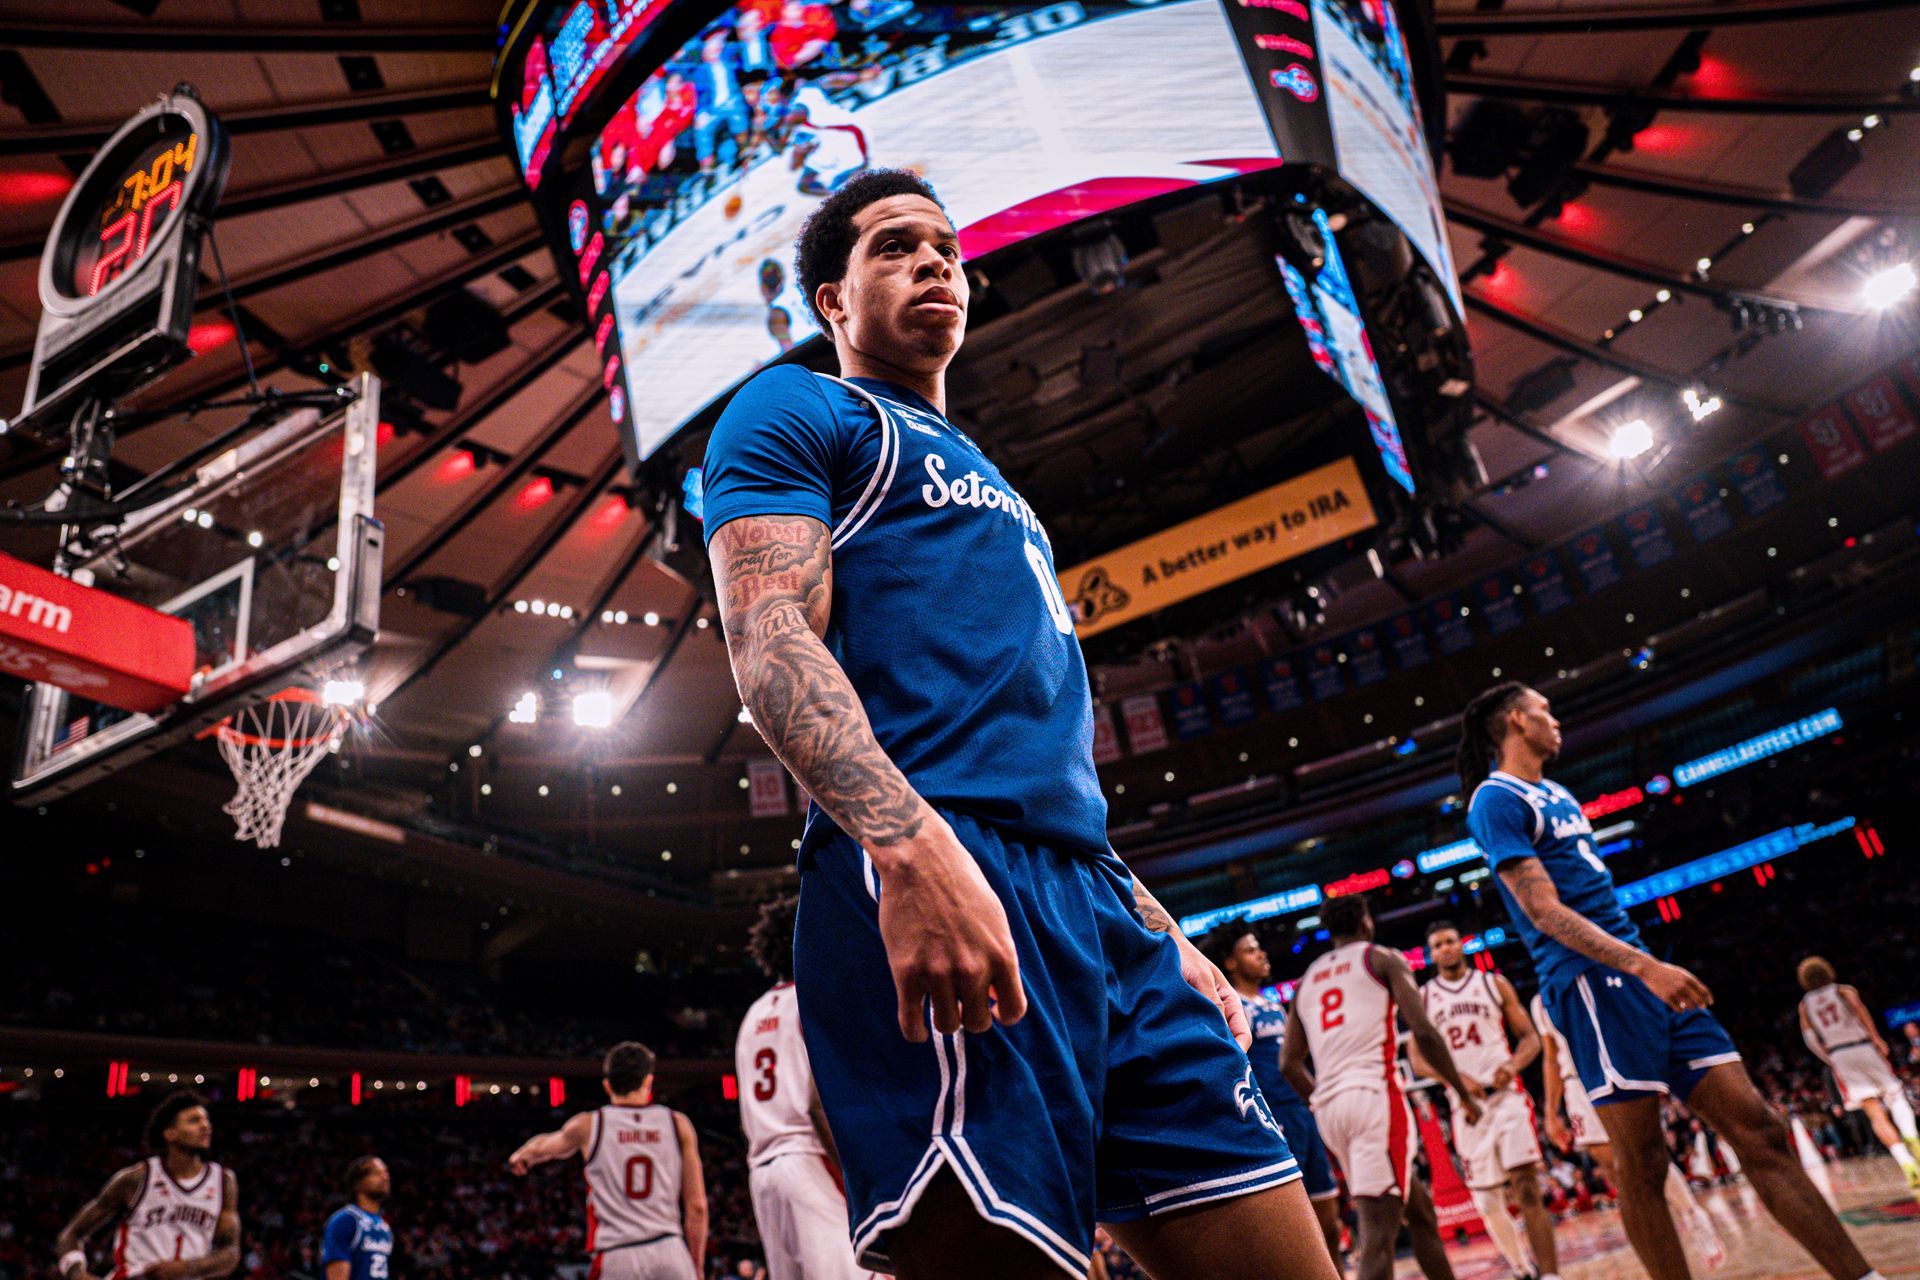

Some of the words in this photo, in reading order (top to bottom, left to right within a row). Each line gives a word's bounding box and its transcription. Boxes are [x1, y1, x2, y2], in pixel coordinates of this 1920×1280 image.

[124, 133, 198, 210] 7:04
[922, 453, 1021, 520] Seton
[721, 519, 808, 555] Worst
[767, 547, 793, 569] for
[1142, 563, 1157, 585] A
[1159, 541, 1227, 578] better
[1232, 520, 1277, 549] way
[1280, 509, 1306, 531] to
[1307, 489, 1349, 519] IRA
[1023, 538, 1073, 636] 0
[1320, 987, 1344, 1033] 2
[1447, 1022, 1482, 1050] 24
[754, 1047, 777, 1102] 3
[625, 1154, 655, 1200] 0
[173, 1232, 184, 1261] 1
